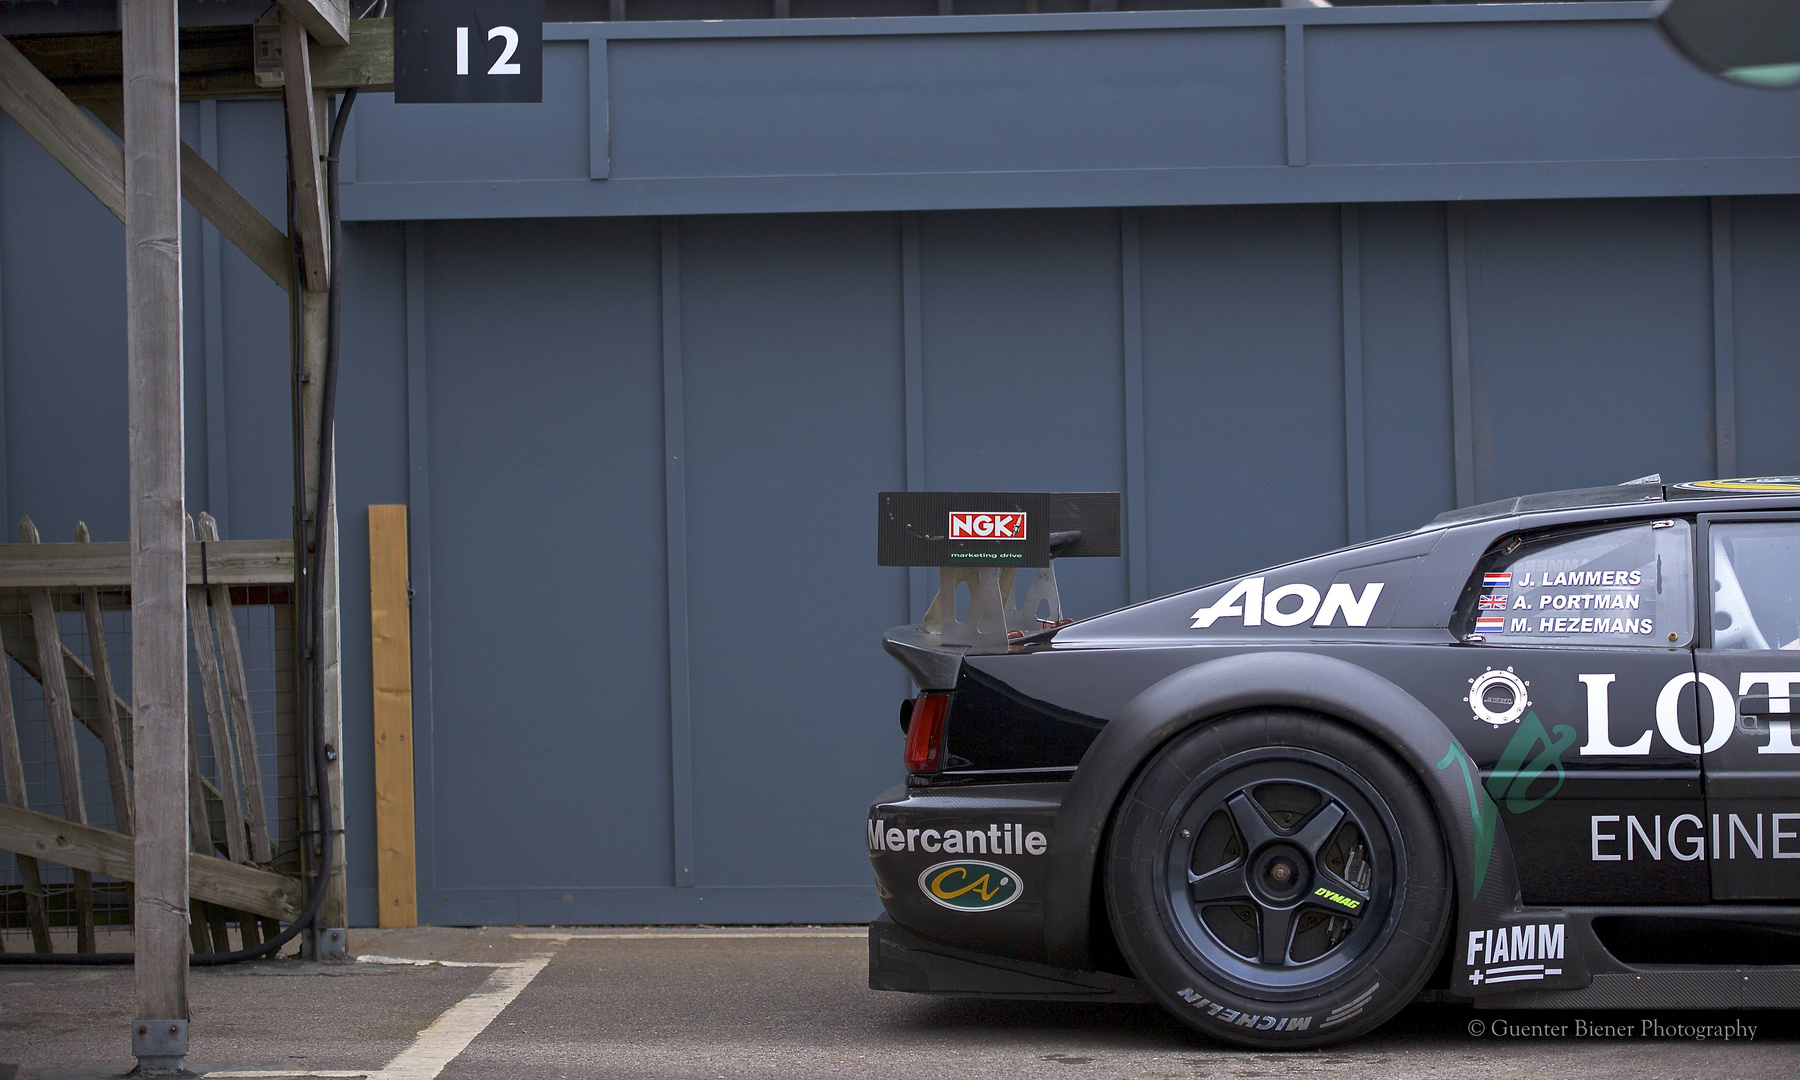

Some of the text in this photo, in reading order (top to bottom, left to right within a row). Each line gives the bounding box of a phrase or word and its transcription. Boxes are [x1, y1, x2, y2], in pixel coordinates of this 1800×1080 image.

[456, 26, 521, 75] 12
[952, 515, 1014, 539] NGK
[950, 552, 998, 560] marketing
[1518, 571, 1642, 587] J. LAMMERS
[1190, 577, 1385, 629] AON
[1512, 594, 1641, 610] A. PORTMAN
[1510, 617, 1654, 635] M. HEZEMANS
[1578, 672, 1800, 756] LOT
[867, 819, 1048, 856] Mercantile
[1591, 813, 1800, 861] ENGINE
[1314, 887, 1360, 909] DYMAG
[1466, 924, 1566, 966] FIAMM
[1176, 987, 1313, 1031] MICHELIN
